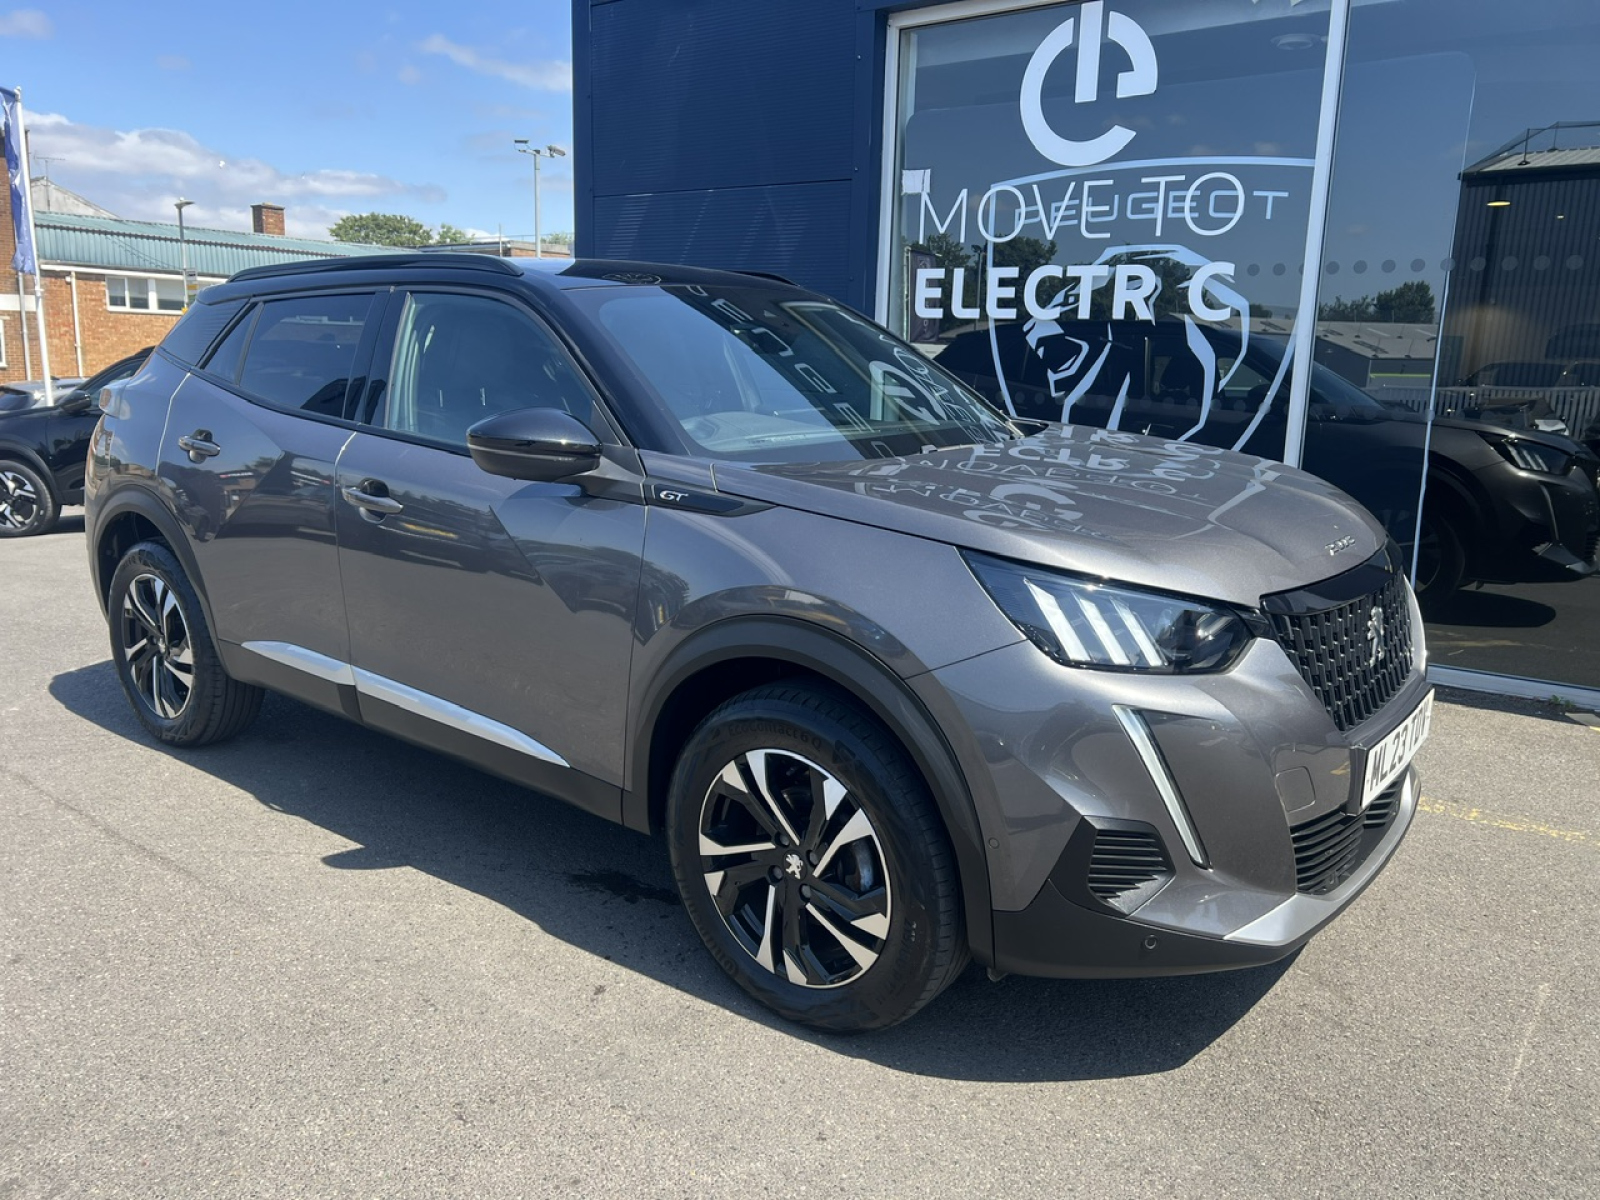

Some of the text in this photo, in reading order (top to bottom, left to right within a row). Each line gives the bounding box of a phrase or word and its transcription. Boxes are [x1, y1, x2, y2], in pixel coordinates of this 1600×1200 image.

[919, 172, 1246, 244] MOVE TO
[1014, 190, 1290, 229] PEUGEOT
[915, 262, 1236, 321] ELECTRC
[660, 490, 690, 502] GT
[1369, 723, 1409, 792] ML23
